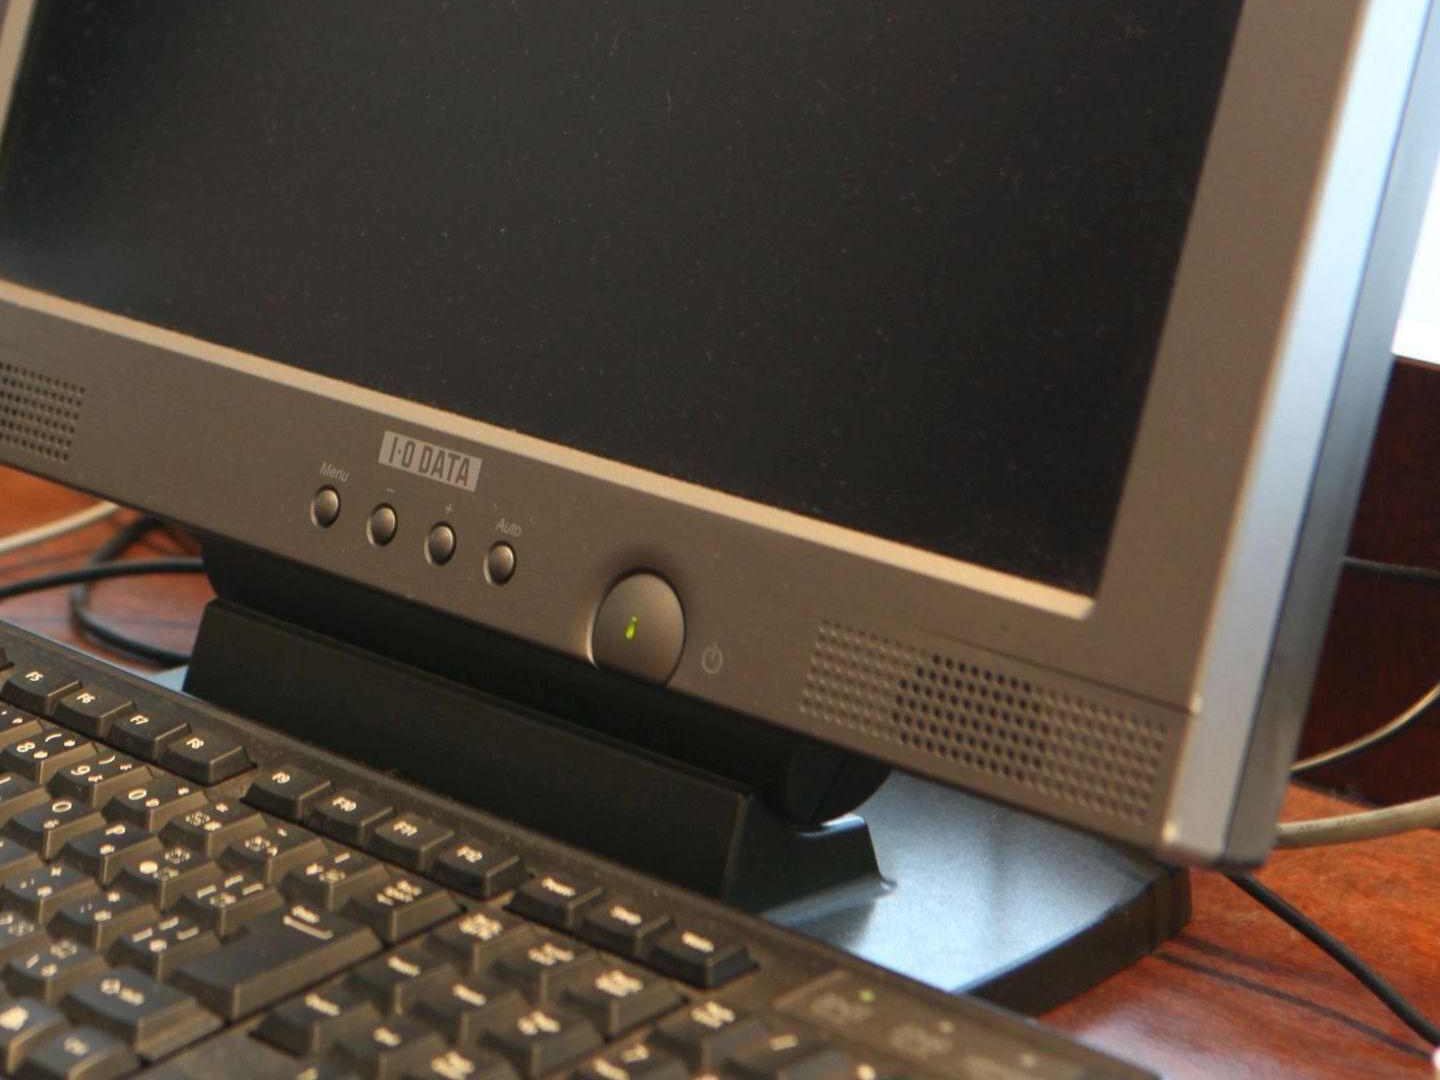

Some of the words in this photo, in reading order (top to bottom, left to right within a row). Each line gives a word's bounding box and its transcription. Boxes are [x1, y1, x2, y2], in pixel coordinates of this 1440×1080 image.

[418, 446, 471, 487] DATA
[319, 462, 350, 483] Menu
[495, 517, 523, 538] Auto
[26, 672, 43, 681] F5
[77, 693, 95, 703] F6
[130, 715, 148, 724] F7
[17, 742, 35, 752] 8
[187, 738, 204, 748] F8
[71, 766, 90, 775] 9
[272, 772, 290, 783] F9
[128, 788, 148, 801] 0
[52, 801, 72, 812] O
[333, 797, 356, 811] F10
[106, 825, 125, 835] P
